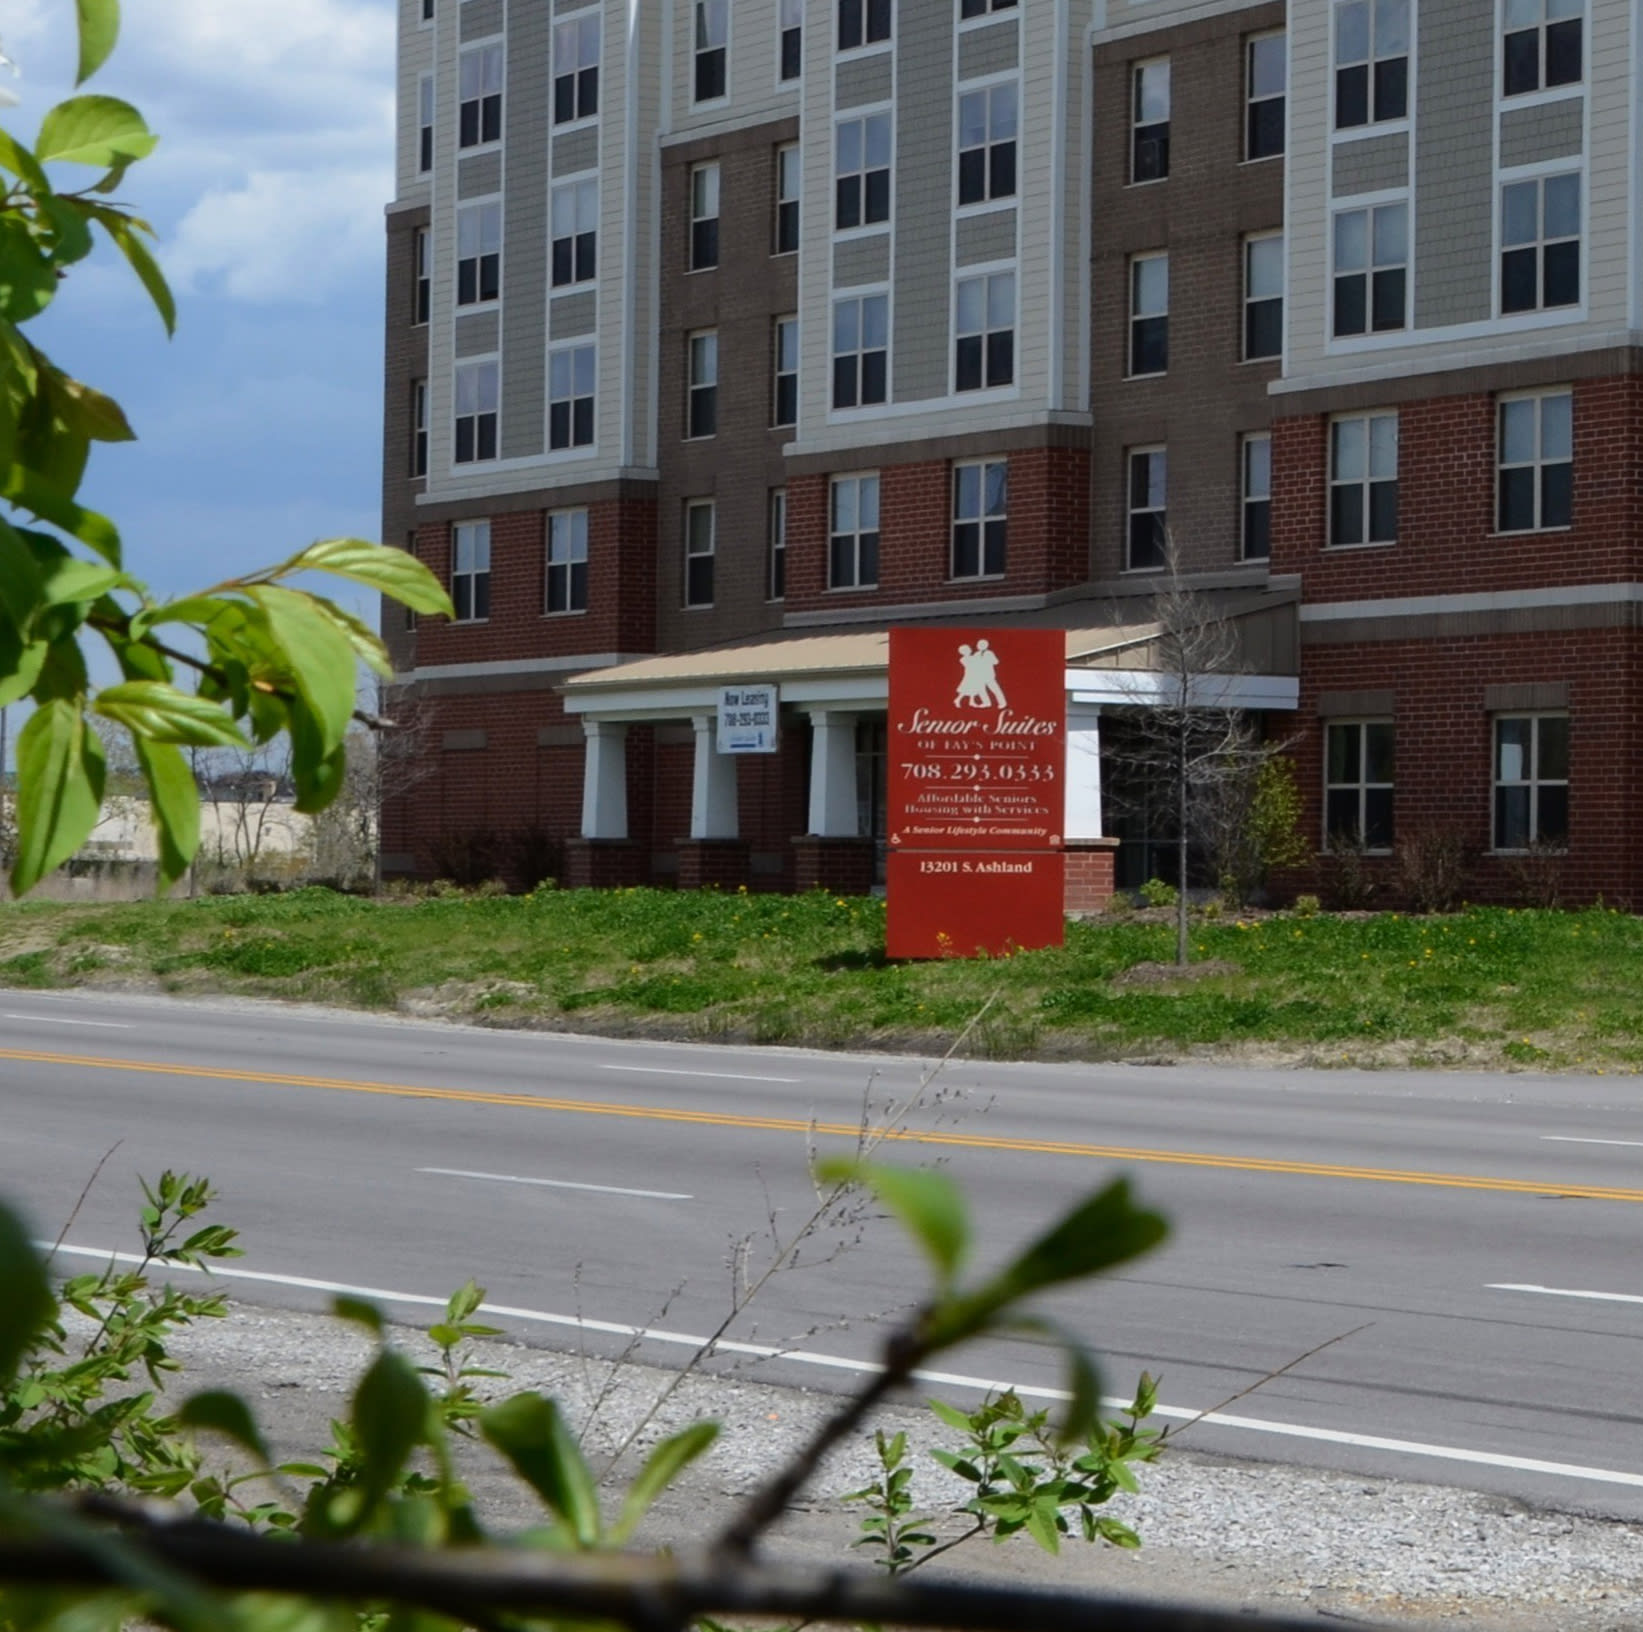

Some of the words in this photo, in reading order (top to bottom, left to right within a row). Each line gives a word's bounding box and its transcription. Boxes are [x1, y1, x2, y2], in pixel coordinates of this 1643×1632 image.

[897, 707, 978, 735] Senior
[983, 708, 1058, 735] Suites
[918, 740, 936, 750] OF
[990, 740, 1036, 751] POINT
[900, 763, 1056, 782] 708.293.0333
[917, 793, 985, 804] Affordable
[990, 794, 1038, 804] Seniors
[905, 805, 959, 816] Housing
[963, 805, 992, 815] with
[996, 805, 1049, 815] Services
[902, 826, 911, 834] A
[912, 826, 945, 834] Senior
[947, 826, 988, 837] Lifestyle
[989, 827, 1048, 837] Community
[920, 861, 958, 873] 13201
[962, 861, 973, 873] S.
[975, 862, 1033, 873] Ashland
